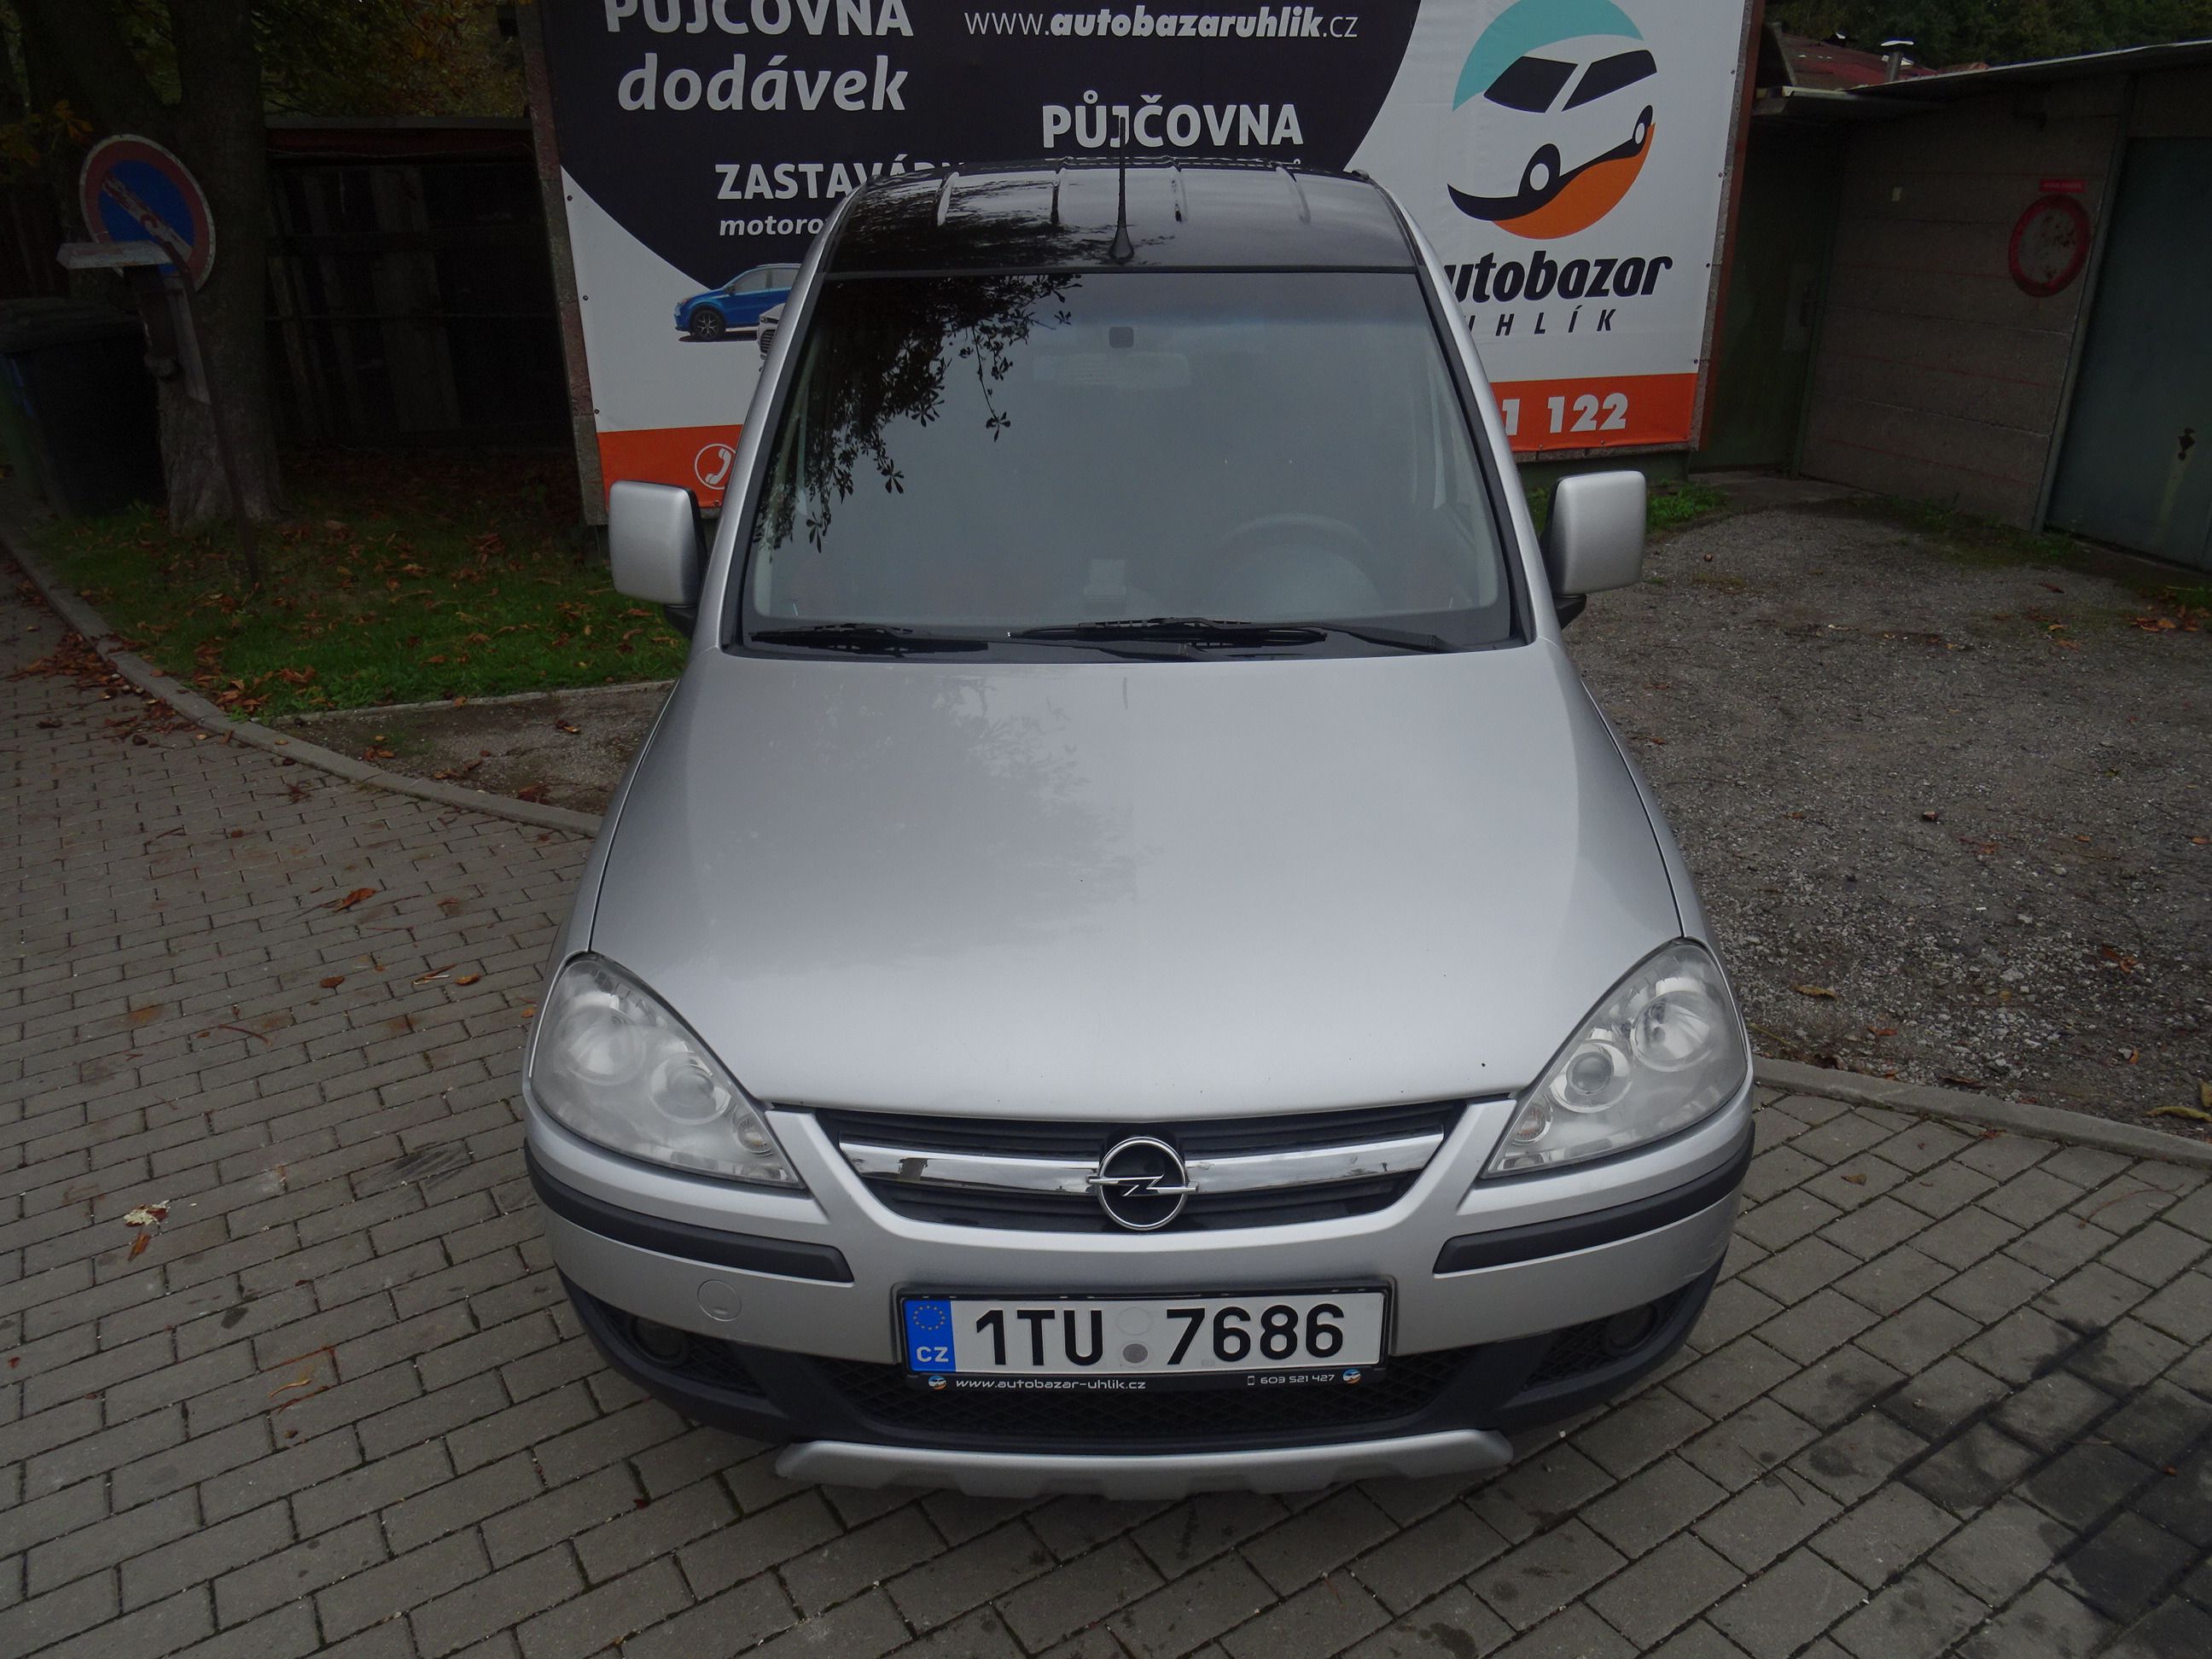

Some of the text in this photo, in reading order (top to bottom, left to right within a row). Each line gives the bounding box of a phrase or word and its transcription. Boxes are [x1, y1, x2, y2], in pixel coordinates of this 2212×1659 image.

[964, 5, 1359, 38] www.autobazaruhlik.cz
[618, 52, 908, 111] dodávek
[1042, 90, 1304, 148] PŮJČOVNA
[719, 216, 830, 236] motoro
[1444, 250, 1673, 304] utobazar
[1547, 393, 1629, 434] 122
[916, 1346, 949, 1363] CZ
[975, 1303, 1345, 1366] 1TU 7686
[956, 1379, 1146, 1391] www.autobazar-uhlik.cz
